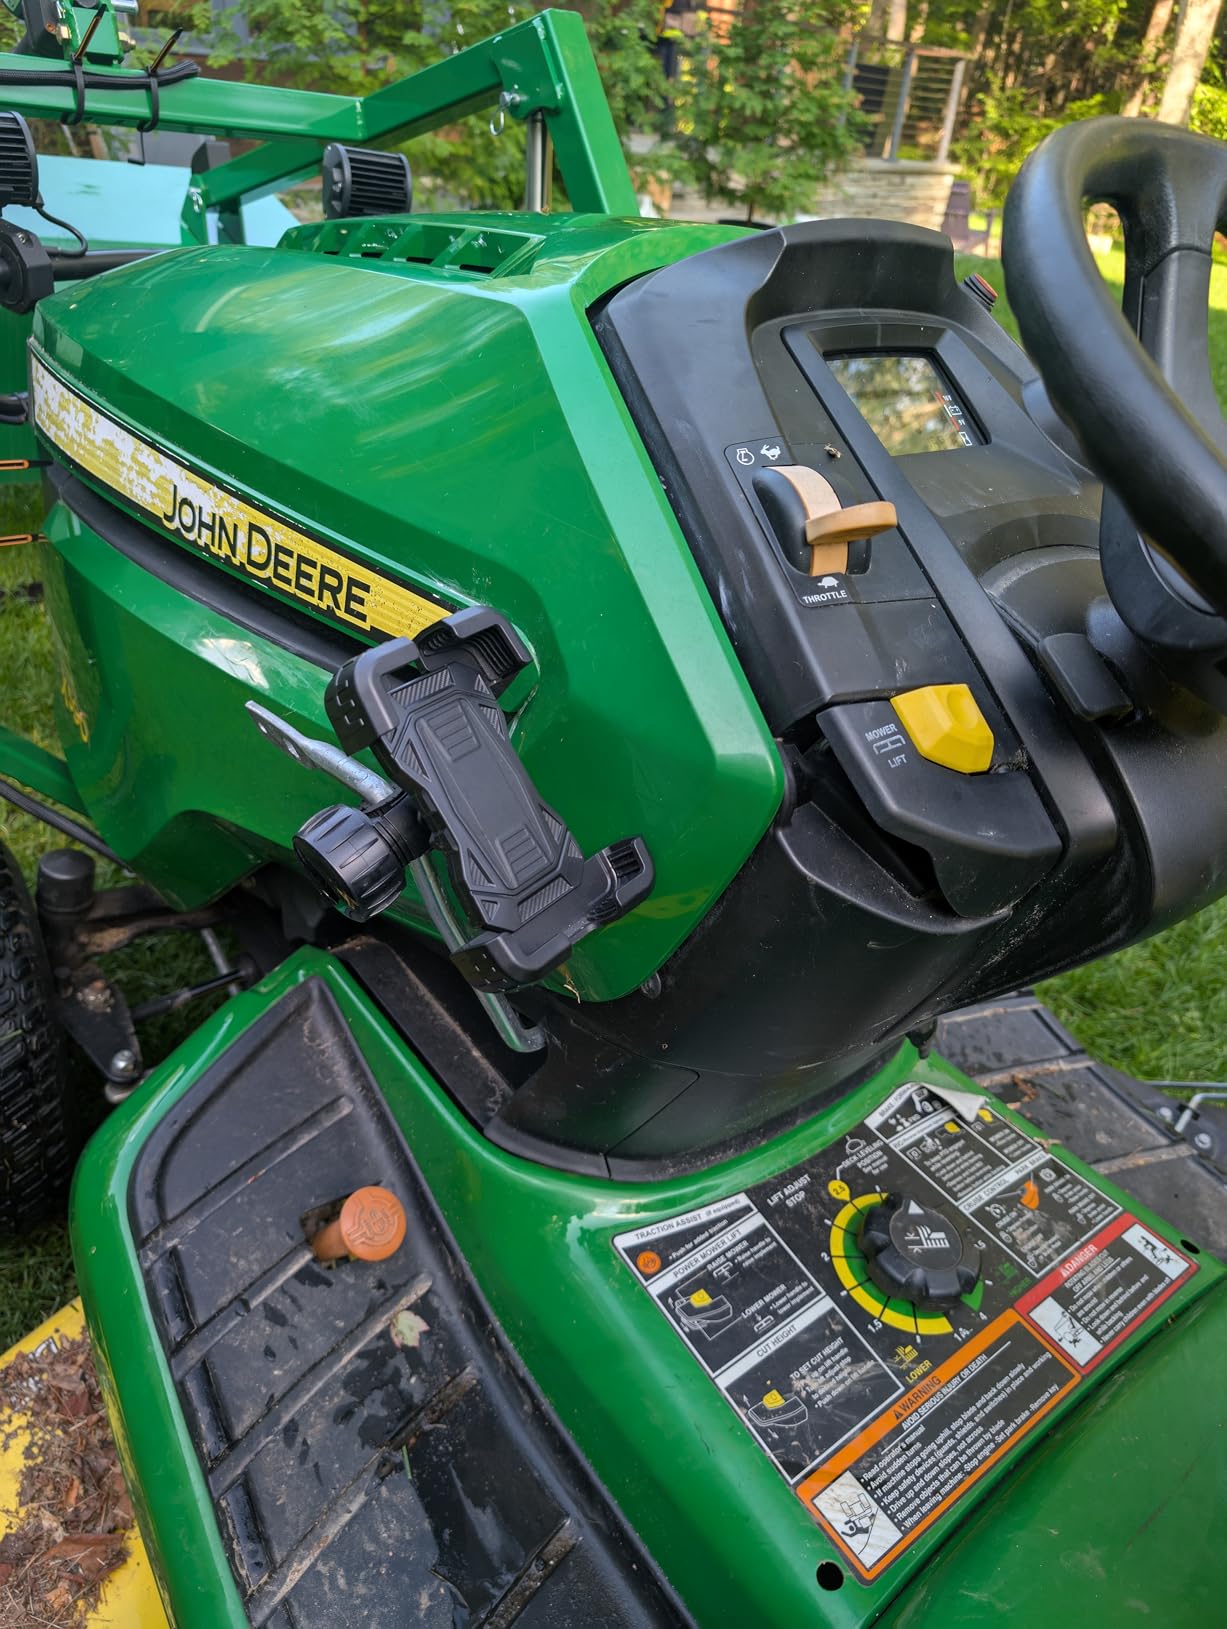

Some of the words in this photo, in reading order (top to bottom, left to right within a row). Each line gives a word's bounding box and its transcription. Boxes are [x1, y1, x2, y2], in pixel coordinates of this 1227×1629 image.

[164, 484, 238, 558] JOHN
[247, 522, 371, 623] DEERE
[803, 589, 848, 604] THROTTLE
[865, 723, 898, 742] MOWER
[888, 754, 908, 769] LIFT
[856, 1150, 883, 1169] POSITION
[857, 1139, 884, 1158] LEVELING
[767, 1190, 784, 1207] LIFT
[783, 1173, 812, 1196] ADJUST
[785, 1190, 806, 1208] STOP
[832, 1184, 846, 1196] 2.5
[963, 1191, 984, 1211] CRUISE
[983, 1178, 1009, 1197] CONTROL
[635, 1223, 675, 1240] TRACTION
[675, 1213, 702, 1228] ASSIST
[672, 1246, 685, 1257] Push
[685, 1241, 693, 1250] for
[693, 1231, 709, 1245] added
[673, 1257, 700, 1277] POWER
[699, 1239, 727, 1259] MOWER
[726, 1229, 741, 1241] LIFT
[706, 1254, 726, 1270] RAISE
[724, 1240, 748, 1257] MOWER
[820, 1252, 830, 1262] 2
[1065, 1244, 1097, 1271] DANGER
[741, 1299, 764, 1318] LOWER
[763, 1284, 786, 1302] MOWER
[756, 1343, 771, 1357] CUT
[770, 1324, 796, 1346] HEIGHT
[867, 1319, 883, 1334] 1.5
[789, 1370, 800, 1380] TO
[798, 1361, 811, 1373] SET
[809, 1352, 823, 1364] CUT
[821, 1336, 843, 1355] HEIGHT
[905, 1360, 933, 1384] LOWER
[817, 1393, 832, 1407] Push
[899, 1375, 941, 1412] WARNING
[901, 1412, 919, 1429] AVOID
[917, 1391, 943, 1415] SERIOUS
[941, 1376, 961, 1394] INJURY
[960, 1368, 970, 1378] OR
[968, 1353, 987, 1371] DEATH
[875, 1488, 882, 1496] If
[881, 1468, 906, 1492] machine
[904, 1455, 921, 1472] stops
[919, 1441, 937, 1459] going
[934, 1427, 952, 1444] uphill,
[949, 1417, 963, 1430] stop
[960, 1405, 977, 1420] blade
[974, 1396, 986, 1408] and
[983, 1386, 997, 1399] back
[995, 1375, 1010, 1389] down
[1008, 1362, 1025, 1378] slowly
[882, 1488, 899, 1505] Keep
[897, 1473, 916, 1492] safety
[914, 1455, 936, 1476] devices
[933, 1437, 957, 1459] (guards,
[954, 1419, 976, 1439] shields,
[973, 1410, 985, 1422] and
[983, 1390, 1008, 1413] switches)
[1010, 1375, 1025, 1390] place
[1022, 1366, 1033, 1377] and
[1031, 1351, 1052, 1370] working
[862, 1464, 879, 1480] Read
[877, 1441, 906, 1468] operator's
[904, 1424, 925, 1444] manual
[869, 1471, 887, 1488] Avoid
[885, 1454, 907, 1474] sudden
[905, 1441, 921, 1456] turns
[889, 1496, 906, 1512] Drive
[905, 1489, 915, 1499] up
[912, 1478, 925, 1491] and
[923, 1465, 940, 1481] down
[937, 1449, 958, 1468] slopes,
[956, 1440, 967, 1451] not
[965, 1425, 983, 1443] across
[903, 1510, 921, 1528] When
[919, 1492, 942, 1514] leaving
[939, 1470, 964, 1495] machine:
[962, 1457, 979, 1472] -Stop
[976, 1442, 995, 1460] engine
[993, 1431, 1006, 1443] -Set
[1003, 1421, 1017, 1436] park
[1013, 1409, 1030, 1424] brake
[1047, 1383, 1059, 1394] key
[896, 1497, 920, 1520] Remove
[918, 1479, 940, 1500] objects
[937, 1468, 951, 1481] that
[949, 1460, 961, 1472] can
[958, 1453, 967, 1462] be
[965, 1437, 984, 1456] thrown
[982, 1431, 992, 1440] by
[989, 1418, 1005, 1433] blade
